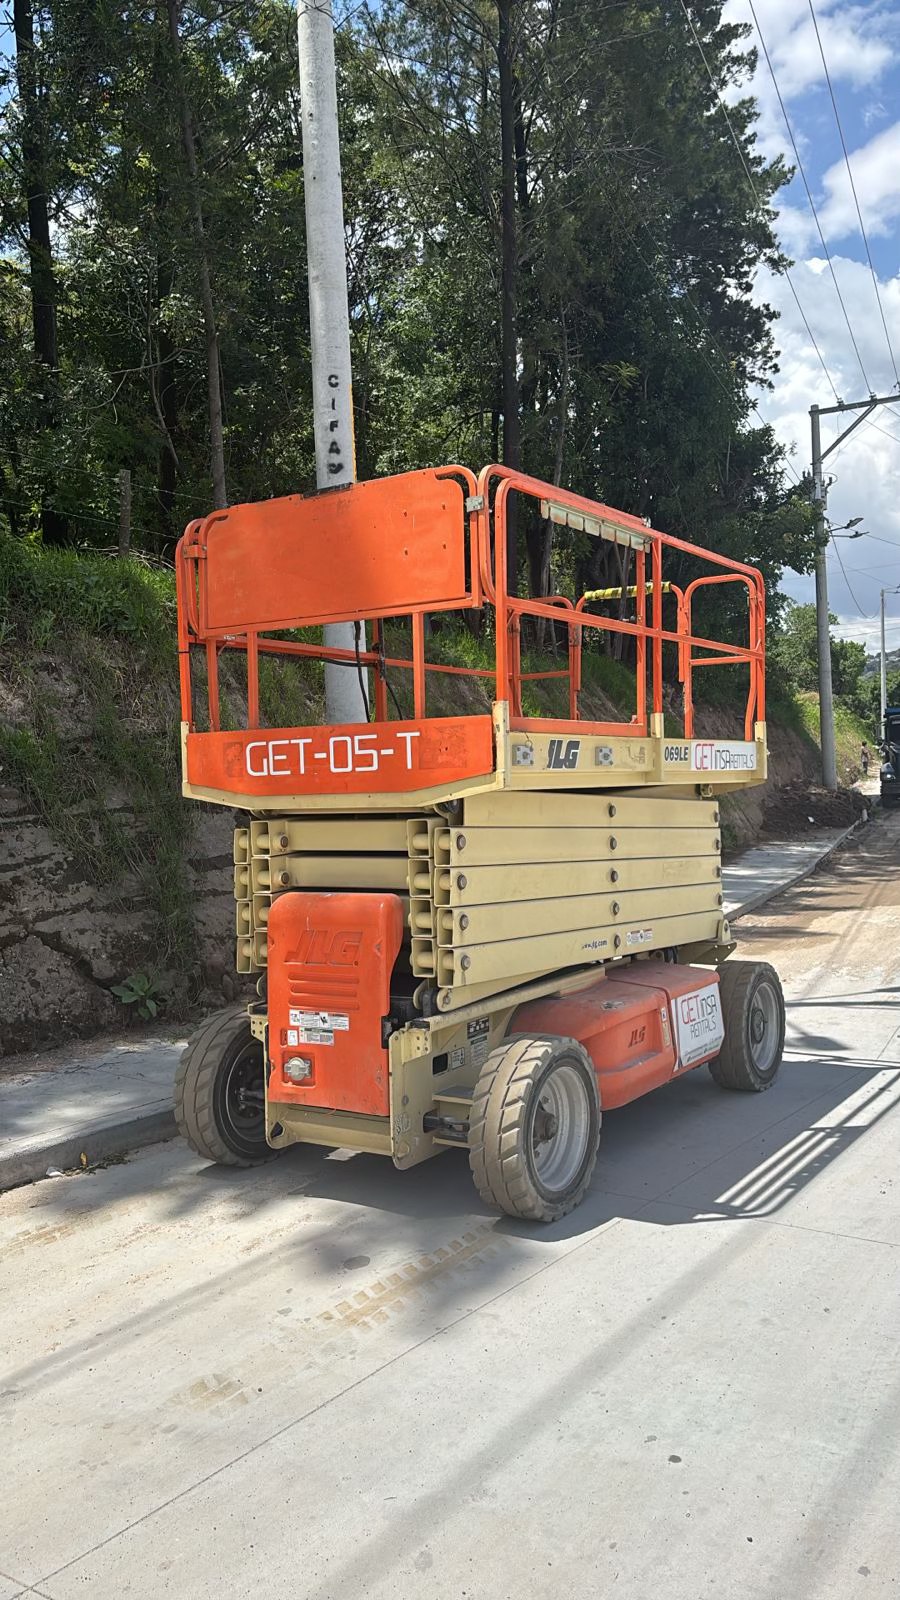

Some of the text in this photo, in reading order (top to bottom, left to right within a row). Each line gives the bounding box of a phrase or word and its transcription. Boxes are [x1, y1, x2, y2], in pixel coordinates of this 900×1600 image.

[245, 731, 421, 777] GET-05-T
[546, 739, 581, 769] JLG
[664, 746, 689, 762] 069LE
[284, 929, 363, 967] JLG
[627, 1025, 646, 1048] JLG
